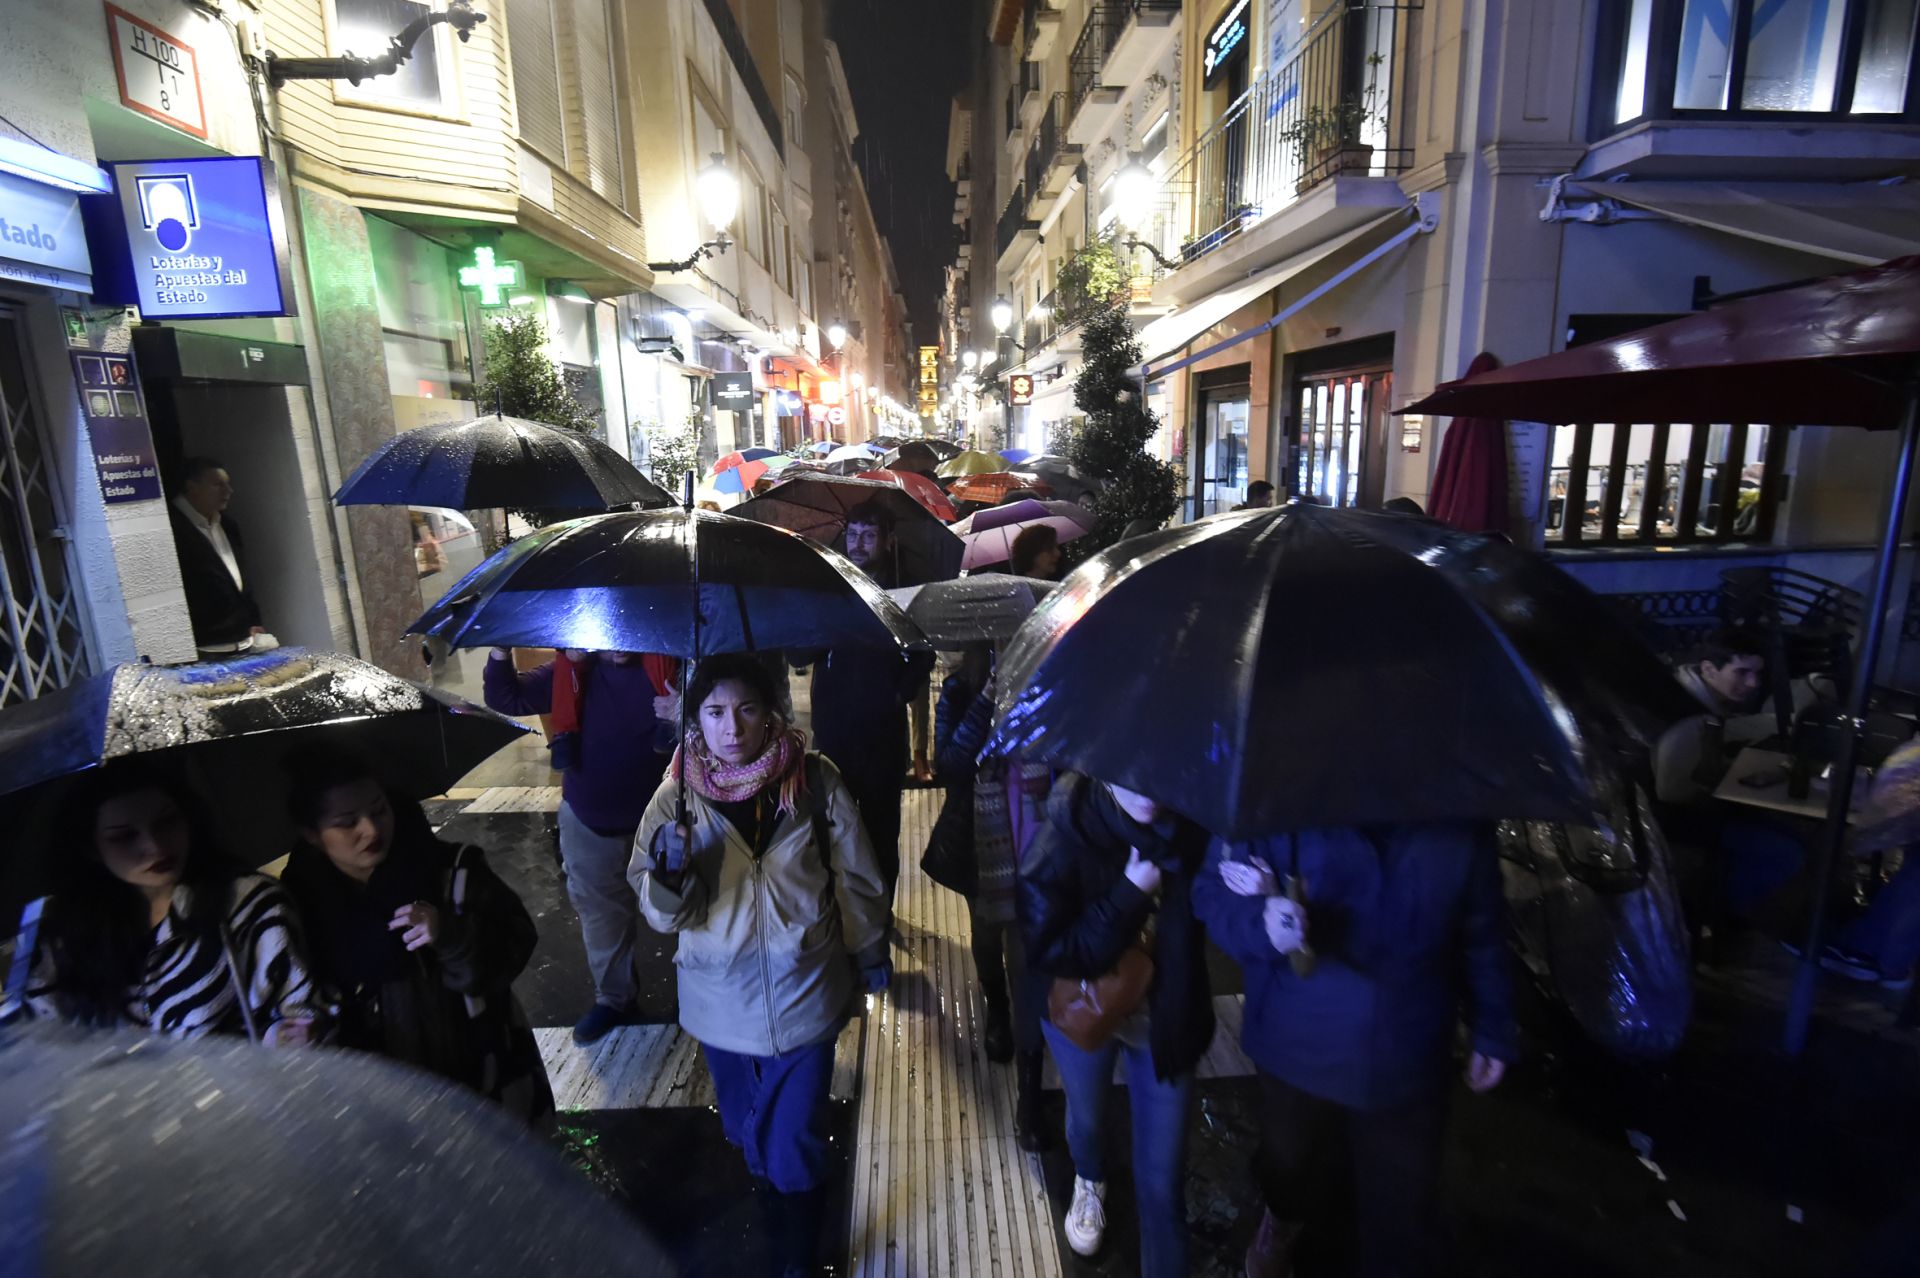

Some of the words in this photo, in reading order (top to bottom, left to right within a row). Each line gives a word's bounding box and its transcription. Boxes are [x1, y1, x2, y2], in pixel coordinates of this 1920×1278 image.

[132, 26, 147, 52] H
[152, 37, 179, 67] 100
[171, 75, 178, 95] 1
[160, 90, 171, 111] 8
[151, 253, 210, 270] Loterías
[211, 256, 222, 271] y
[155, 272, 221, 290] Apuestas
[223, 269, 247, 285] del
[157, 289, 207, 304] Estado
[134, 455, 140, 465] y
[102, 469, 141, 482] Apuestas
[143, 467, 155, 477] del
[105, 485, 135, 497] Estado
